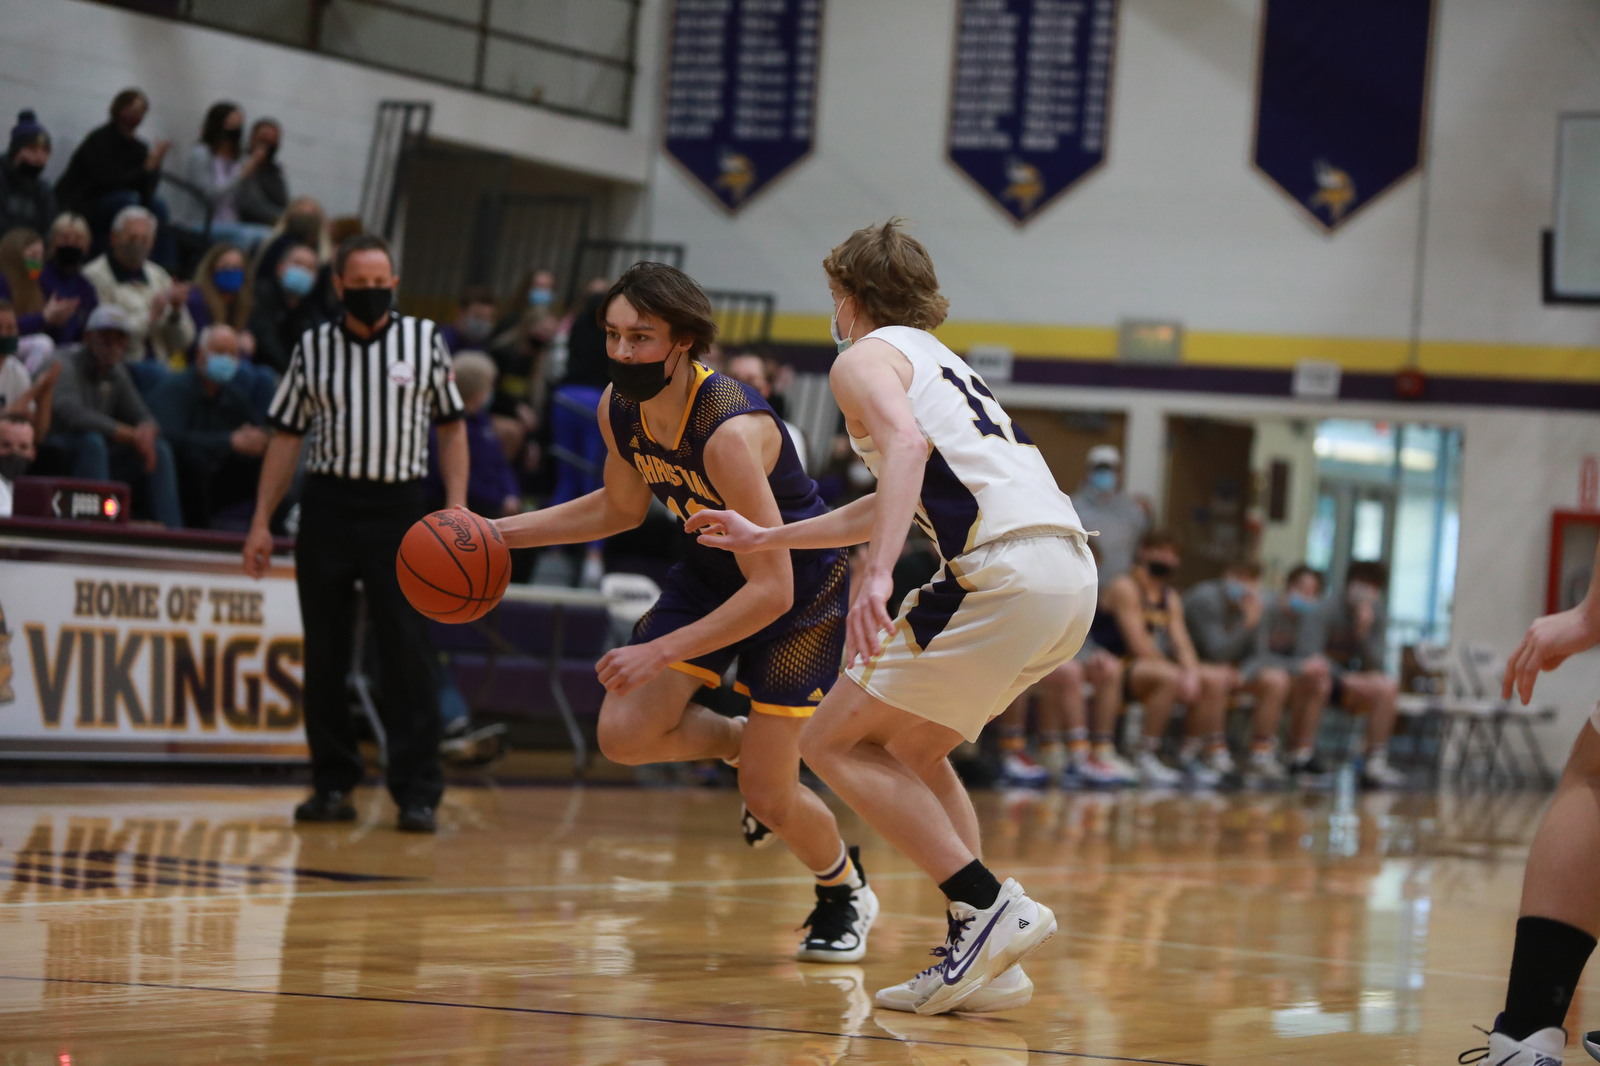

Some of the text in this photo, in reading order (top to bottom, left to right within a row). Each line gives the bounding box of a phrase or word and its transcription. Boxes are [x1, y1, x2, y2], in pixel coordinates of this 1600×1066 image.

[74, 579, 264, 625] HOME OF THE
[24, 622, 305, 732] VIKINGS
